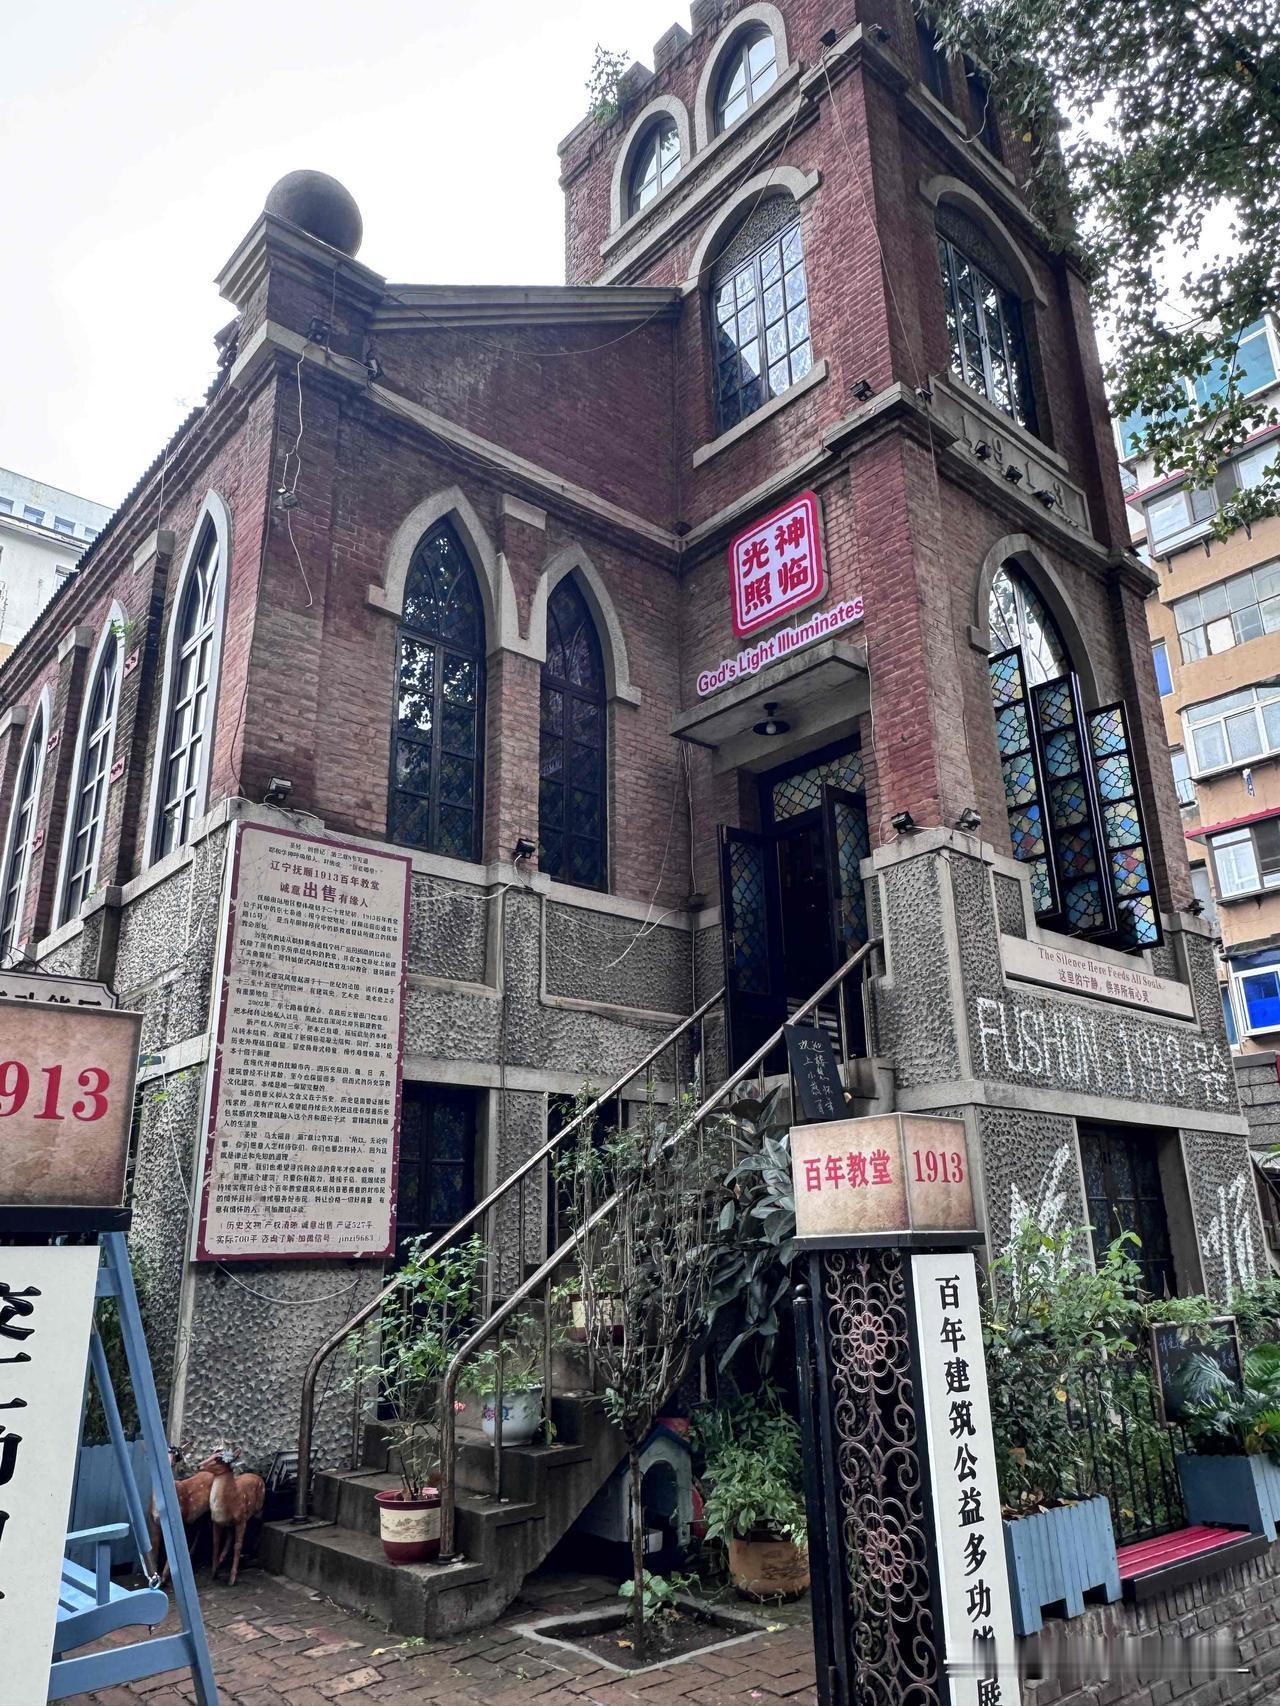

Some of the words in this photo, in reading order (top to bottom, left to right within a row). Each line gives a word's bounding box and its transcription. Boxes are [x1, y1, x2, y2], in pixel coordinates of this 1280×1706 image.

[698, 665, 736, 692] God's
[739, 642, 775, 673] Light
[778, 600, 864, 653] Illuminates
[269, 859, 380, 891] 辽宁抚顺1913百年教堂
[279, 875, 369, 909] 诚意出售有缘人
[1038, 946, 1054, 960] The
[1056, 952, 1086, 970] Silence
[1087, 961, 1107, 976] Here
[1107, 966, 1130, 982] Feeds
[1131, 974, 1142, 985] All
[803, 1149, 893, 1192] 百年教堂
[913, 1150, 964, 1184] 1913
